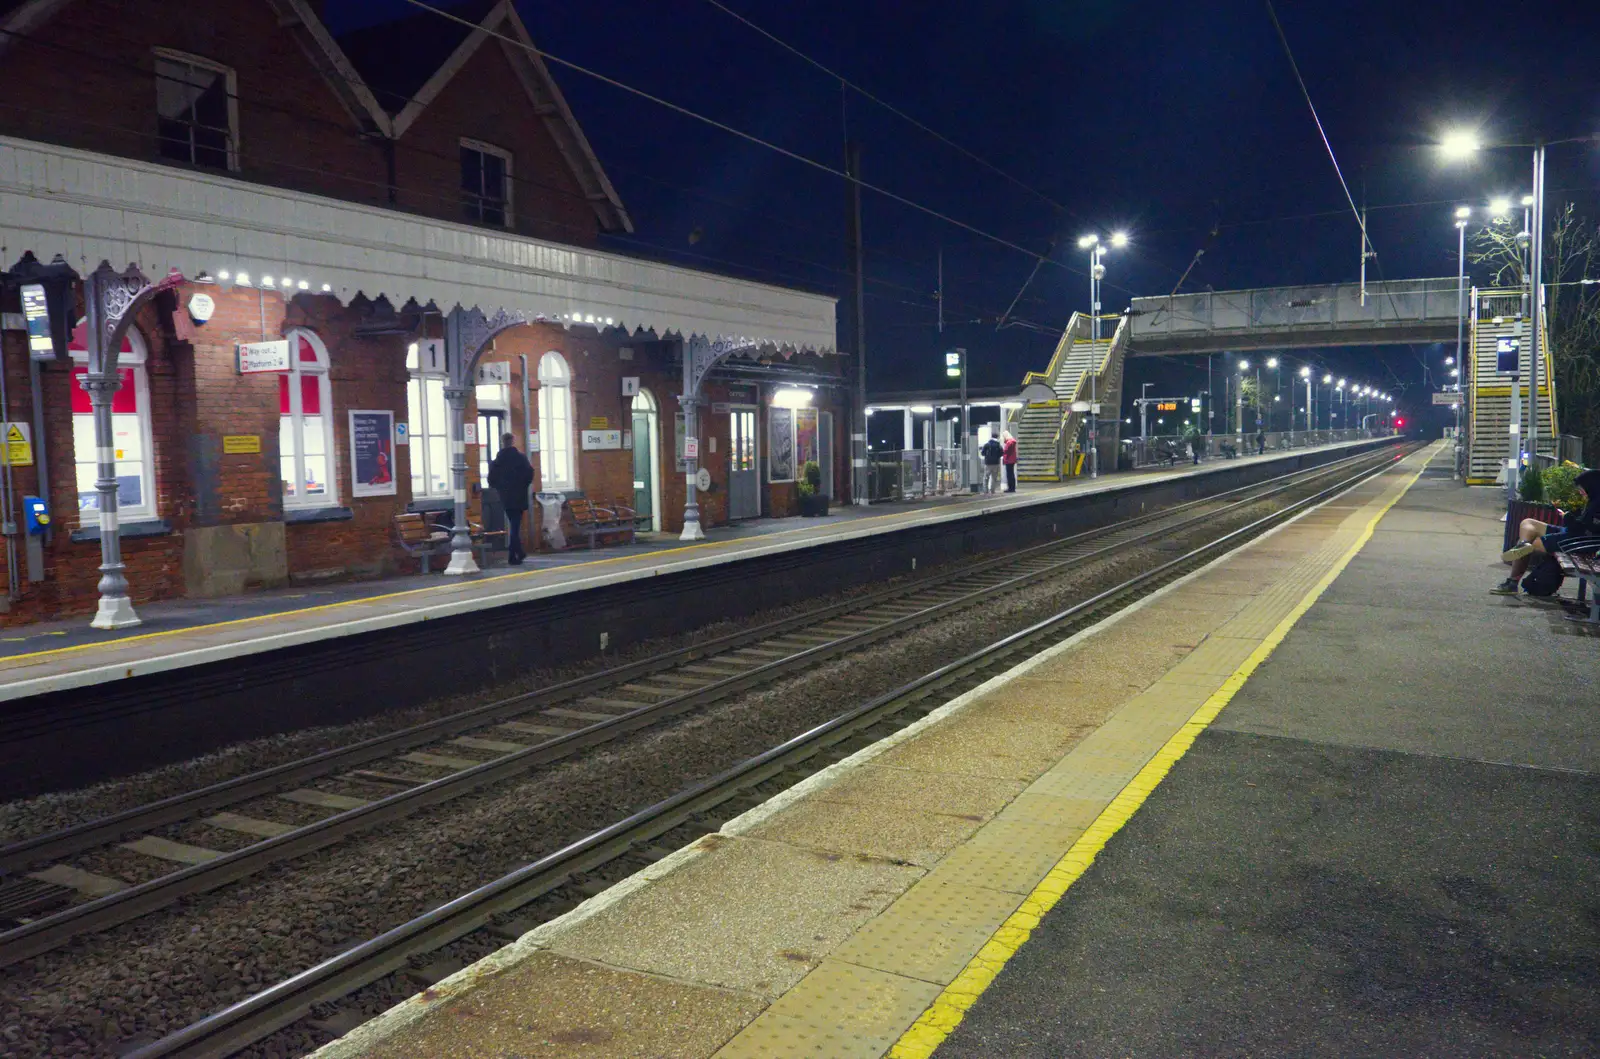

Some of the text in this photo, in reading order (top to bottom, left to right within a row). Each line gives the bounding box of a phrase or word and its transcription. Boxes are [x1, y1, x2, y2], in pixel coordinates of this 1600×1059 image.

[249, 347, 260, 355] Way
[428, 343, 436, 368] 1
[249, 360, 271, 368] Platform
[587, 435, 601, 444] Diss
